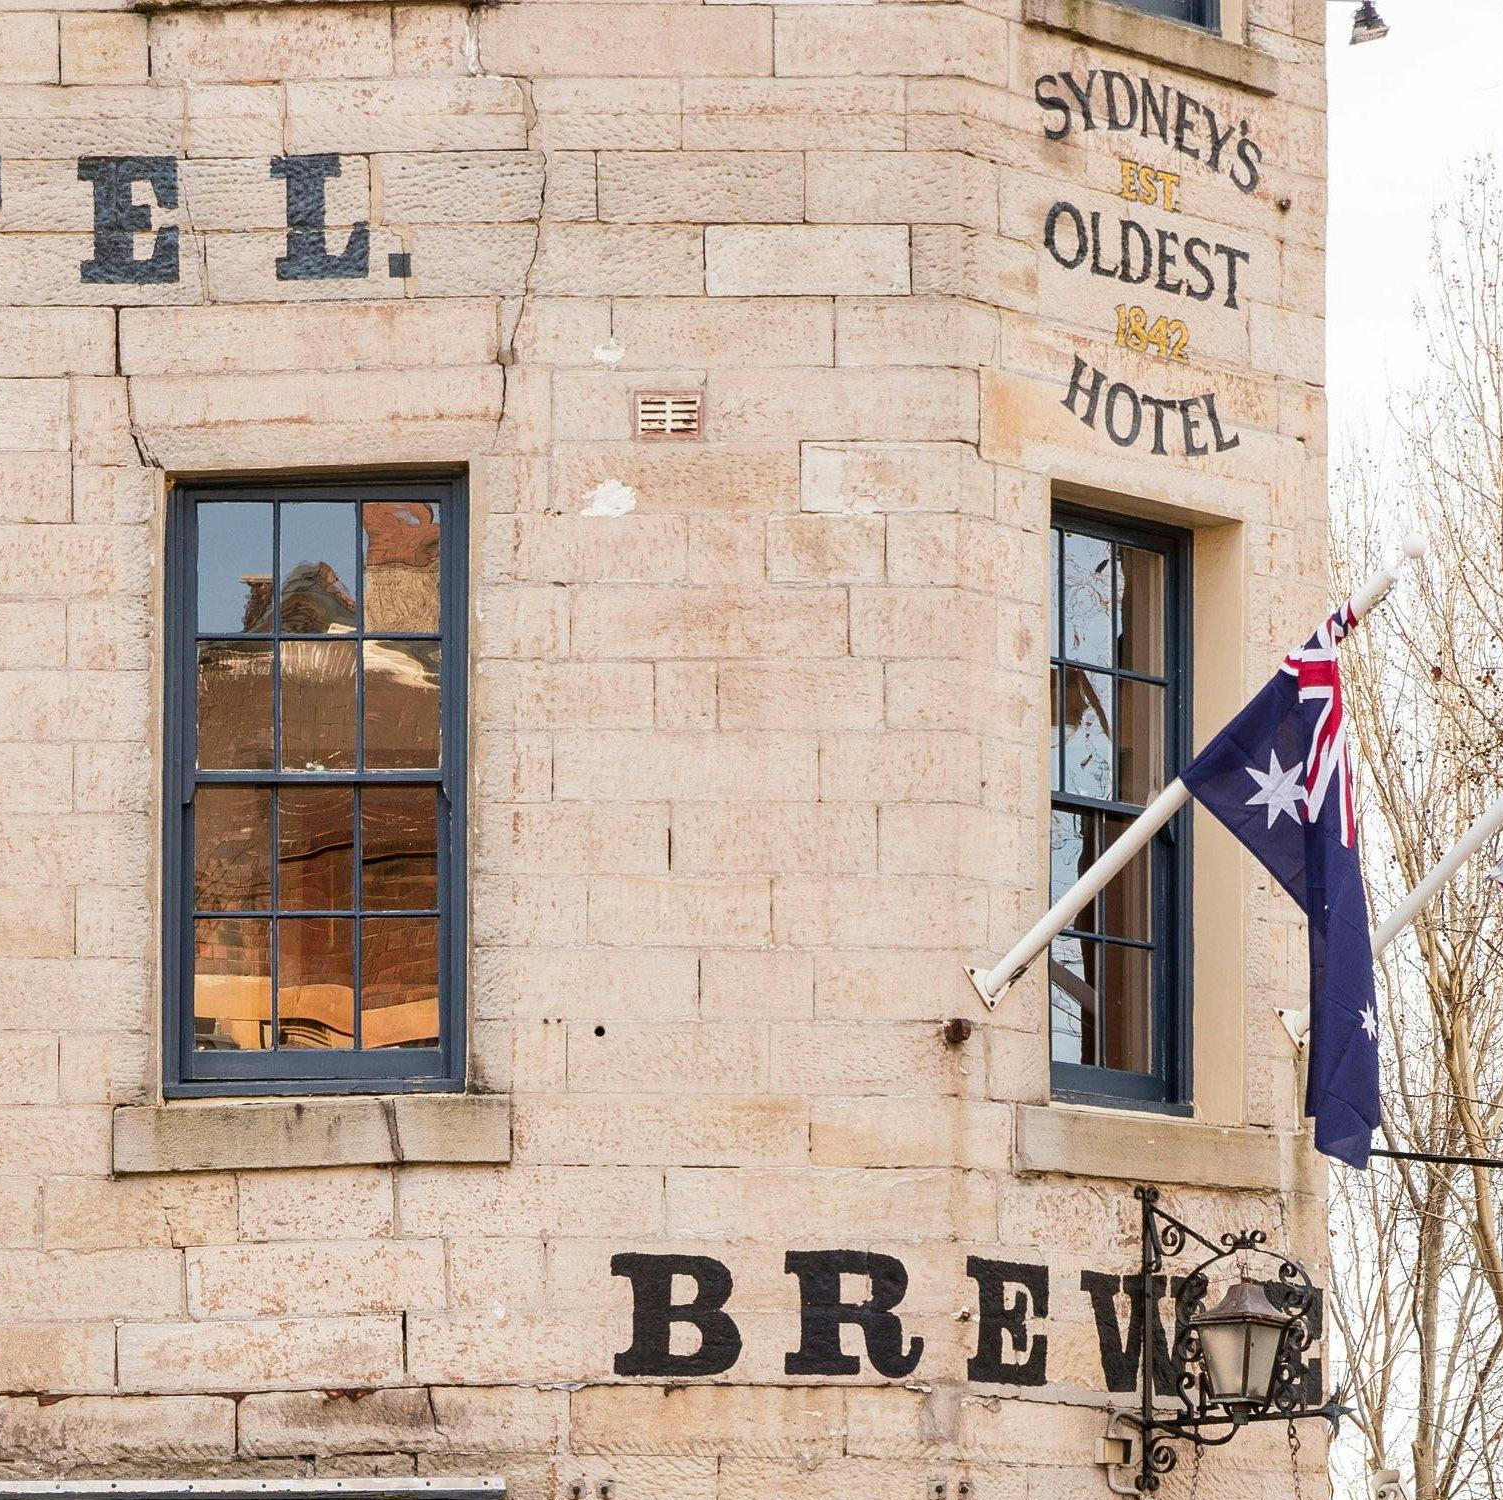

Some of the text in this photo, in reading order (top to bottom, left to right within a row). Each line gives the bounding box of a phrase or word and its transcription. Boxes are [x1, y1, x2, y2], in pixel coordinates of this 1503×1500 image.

[1034, 69, 1263, 194] SYDNEY'S
[1043, 200, 1250, 310] OLDEST
[1114, 303, 1190, 366] 1842
[1060, 353, 1240, 458] HOTEL
